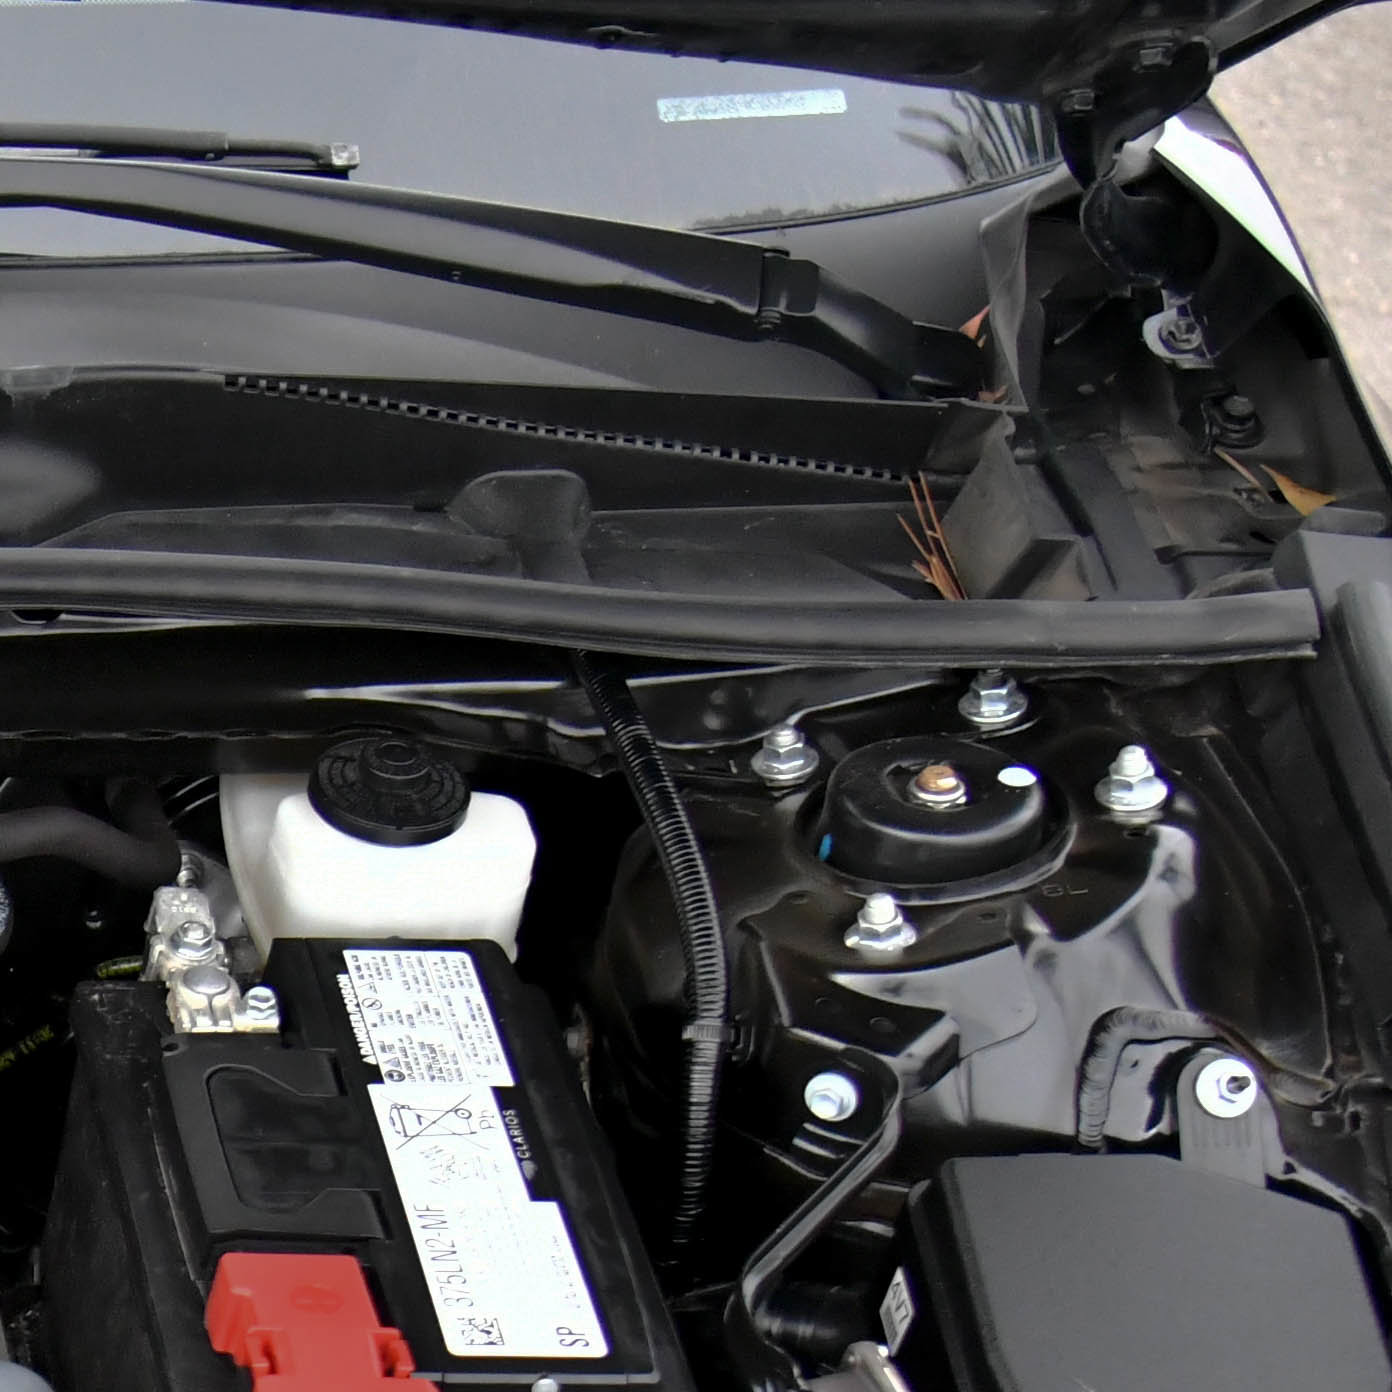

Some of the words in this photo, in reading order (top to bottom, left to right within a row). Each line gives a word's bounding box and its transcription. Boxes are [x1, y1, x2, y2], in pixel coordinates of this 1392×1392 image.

[337, 974, 374, 1056] DANGER/POISON
[504, 1109, 529, 1159] CLARIOS
[413, 1202, 474, 1309] 375LN2-MF
[555, 1325, 590, 1349] SP
